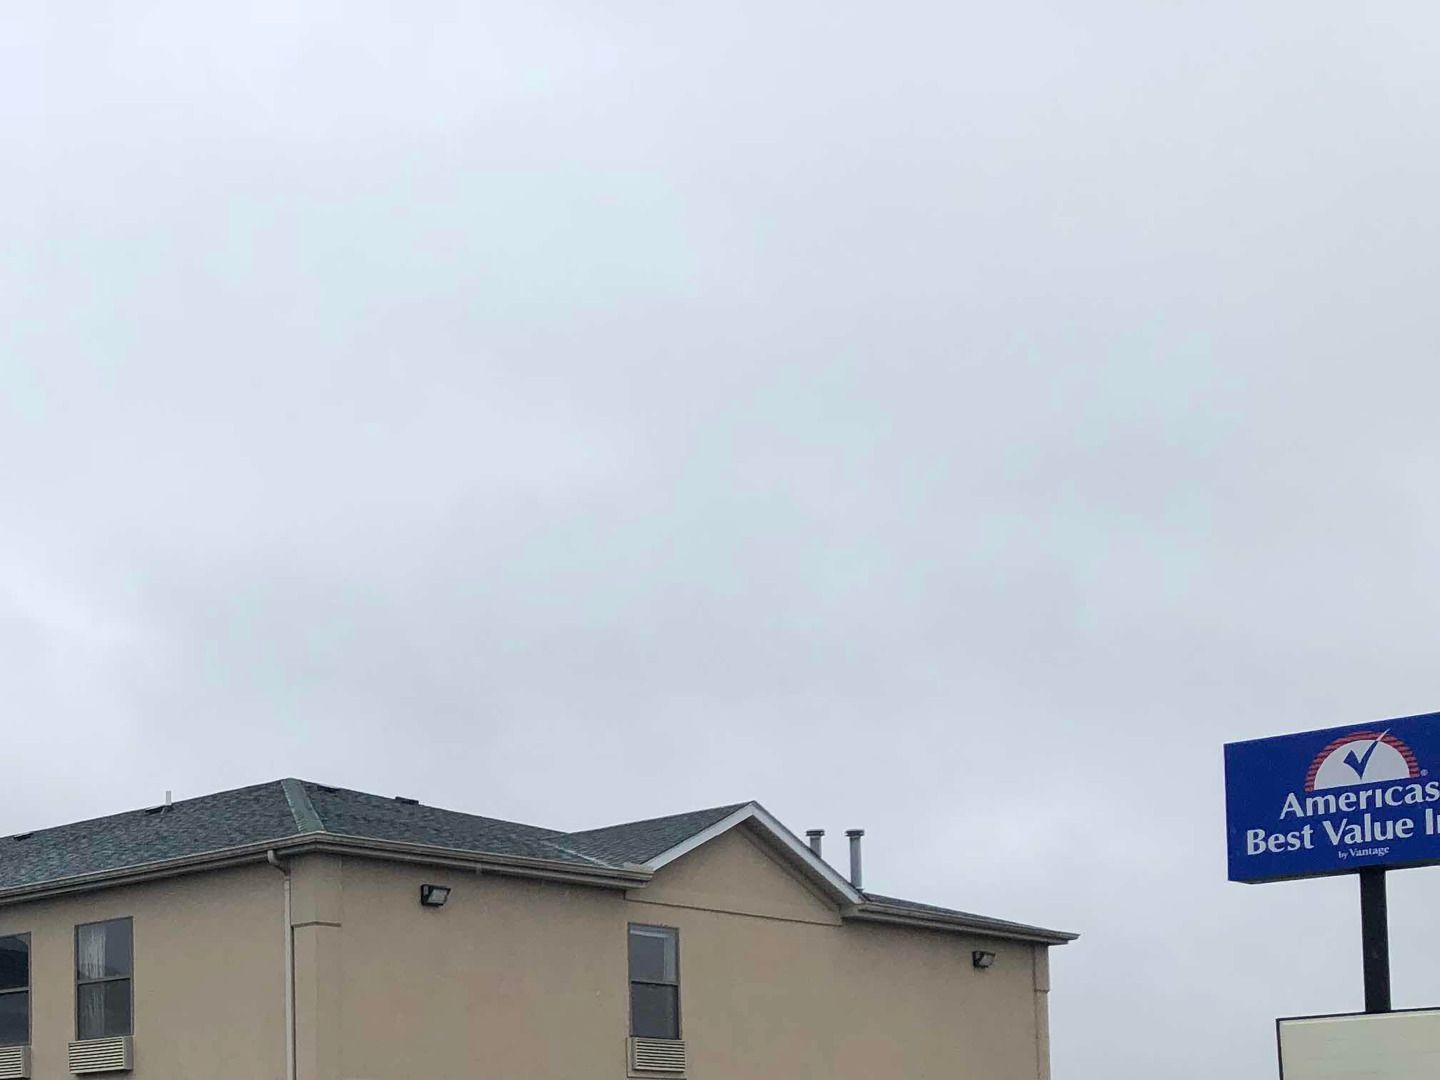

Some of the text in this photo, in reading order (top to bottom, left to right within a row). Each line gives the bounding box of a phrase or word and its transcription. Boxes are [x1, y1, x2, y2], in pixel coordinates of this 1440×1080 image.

[1279, 780, 1440, 820] Americas
[1247, 824, 1314, 855] Best
[1322, 813, 1414, 846] Value
[1338, 846, 1390, 860] by Vantage
